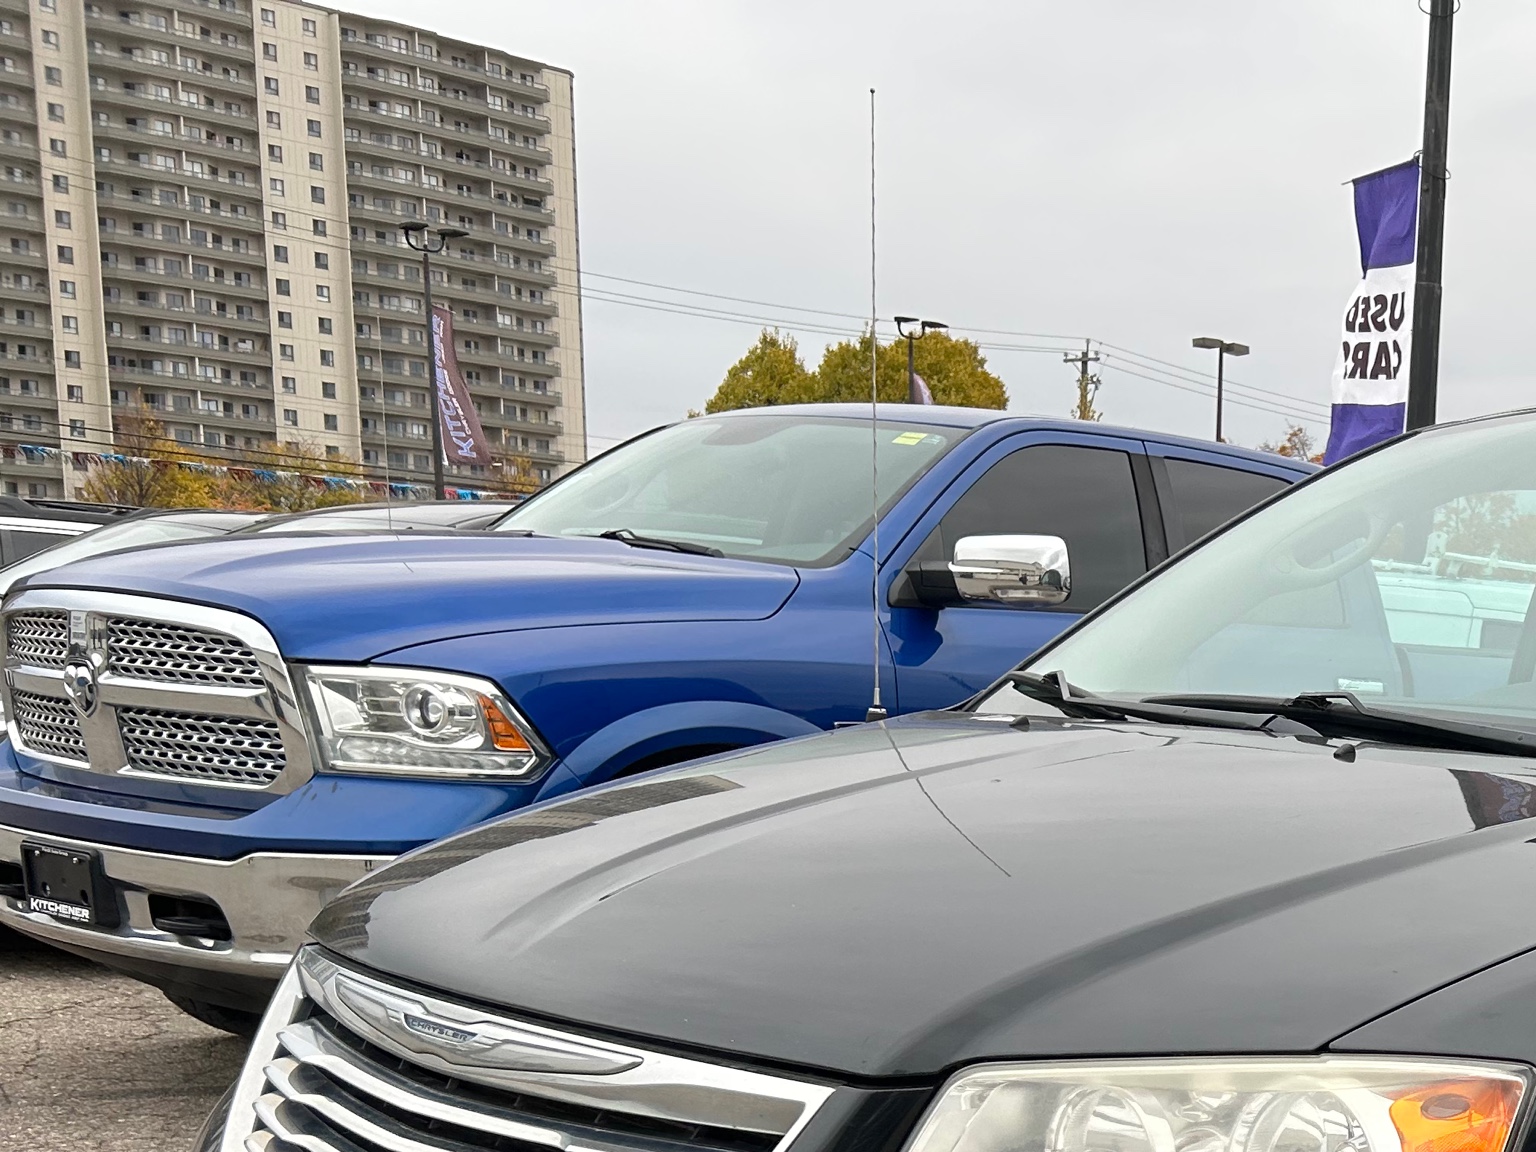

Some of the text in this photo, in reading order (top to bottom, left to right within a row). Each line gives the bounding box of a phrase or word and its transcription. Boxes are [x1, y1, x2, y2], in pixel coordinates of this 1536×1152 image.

[432, 314, 477, 458] KITCHENER
[30, 897, 90, 919] KITCHENER
[410, 1018, 468, 1041] CHRYSLER
